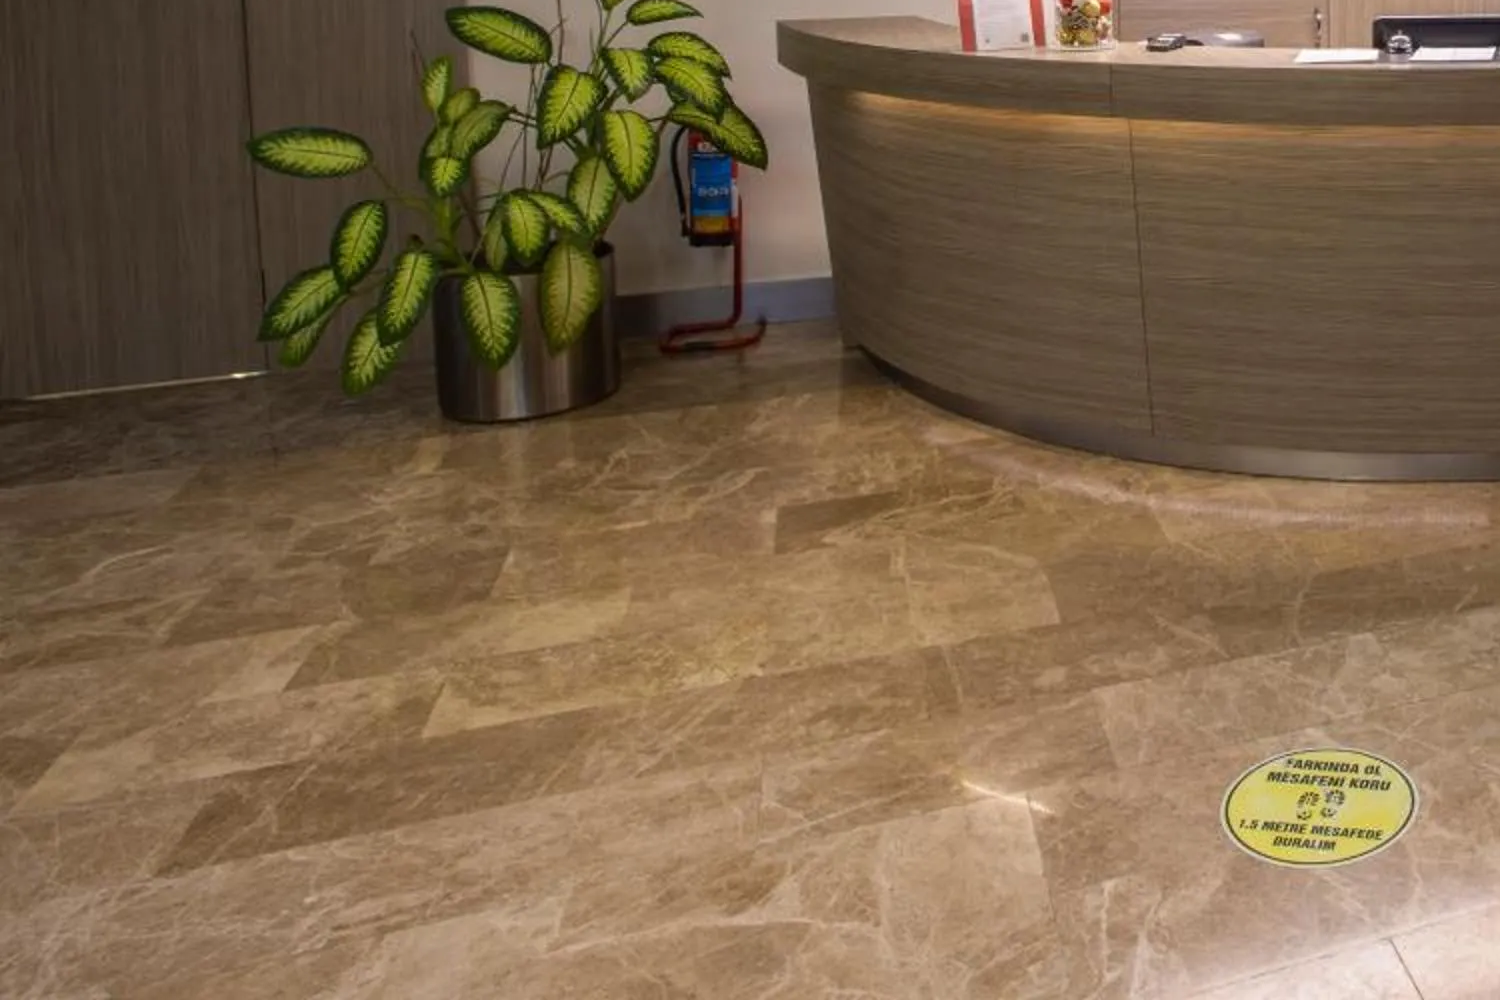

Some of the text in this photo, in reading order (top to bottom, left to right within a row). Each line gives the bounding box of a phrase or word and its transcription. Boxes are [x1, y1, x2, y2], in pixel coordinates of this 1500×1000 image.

[1364, 764, 1382, 776] OL
[1349, 778, 1392, 791] KORU
[1261, 821, 1307, 834] METRE
[1310, 825, 1383, 841] MESAFEDE
[1272, 836, 1337, 851] DURALIM
